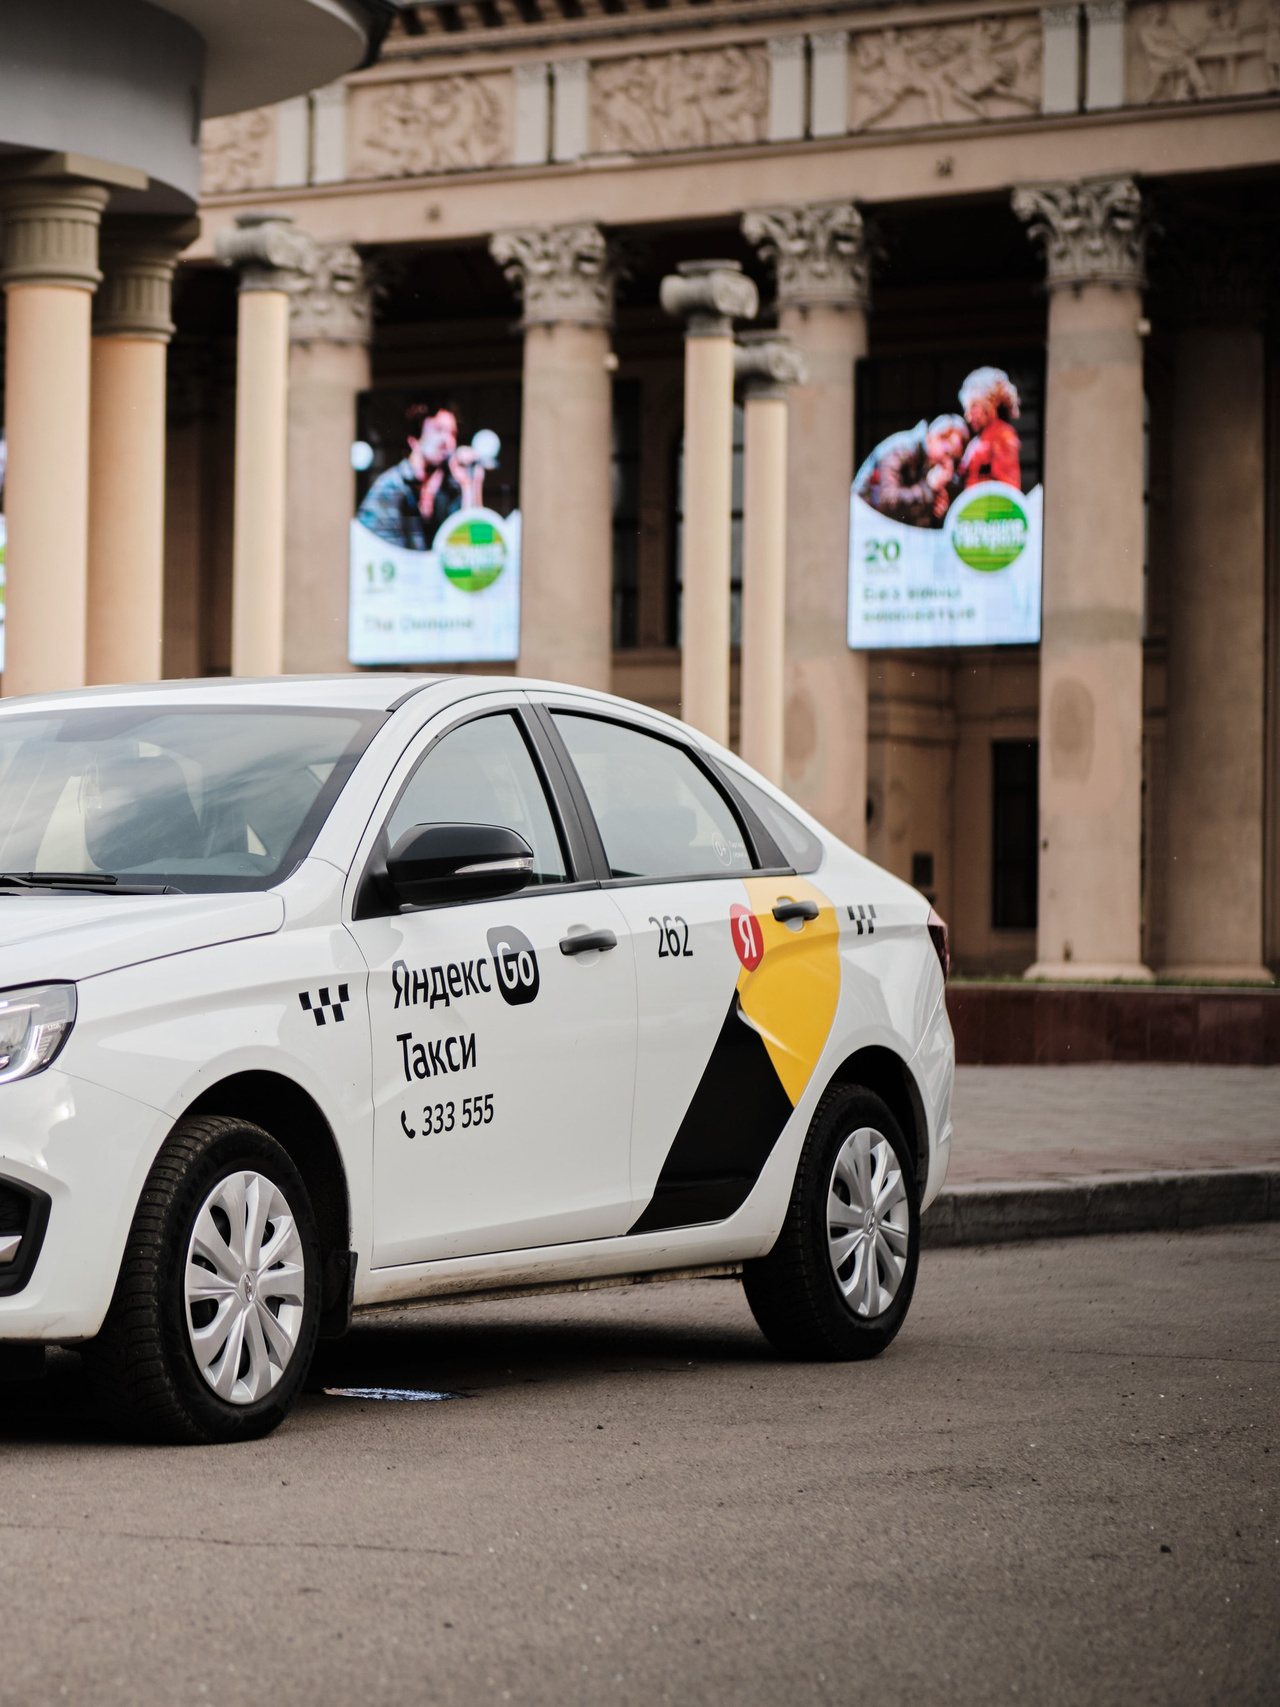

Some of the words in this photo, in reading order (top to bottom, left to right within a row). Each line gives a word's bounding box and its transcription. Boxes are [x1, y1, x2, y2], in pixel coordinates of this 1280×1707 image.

[365, 560, 396, 583] 19
[864, 537, 901, 564] 20
[648, 915, 694, 958] 262
[738, 914, 757, 959] Я
[392, 959, 492, 1009] Яндекс
[496, 941, 535, 990] Go
[396, 1032, 477, 1082] Такси
[422, 1101, 455, 1137] 333
[462, 1093, 494, 1128] 555
